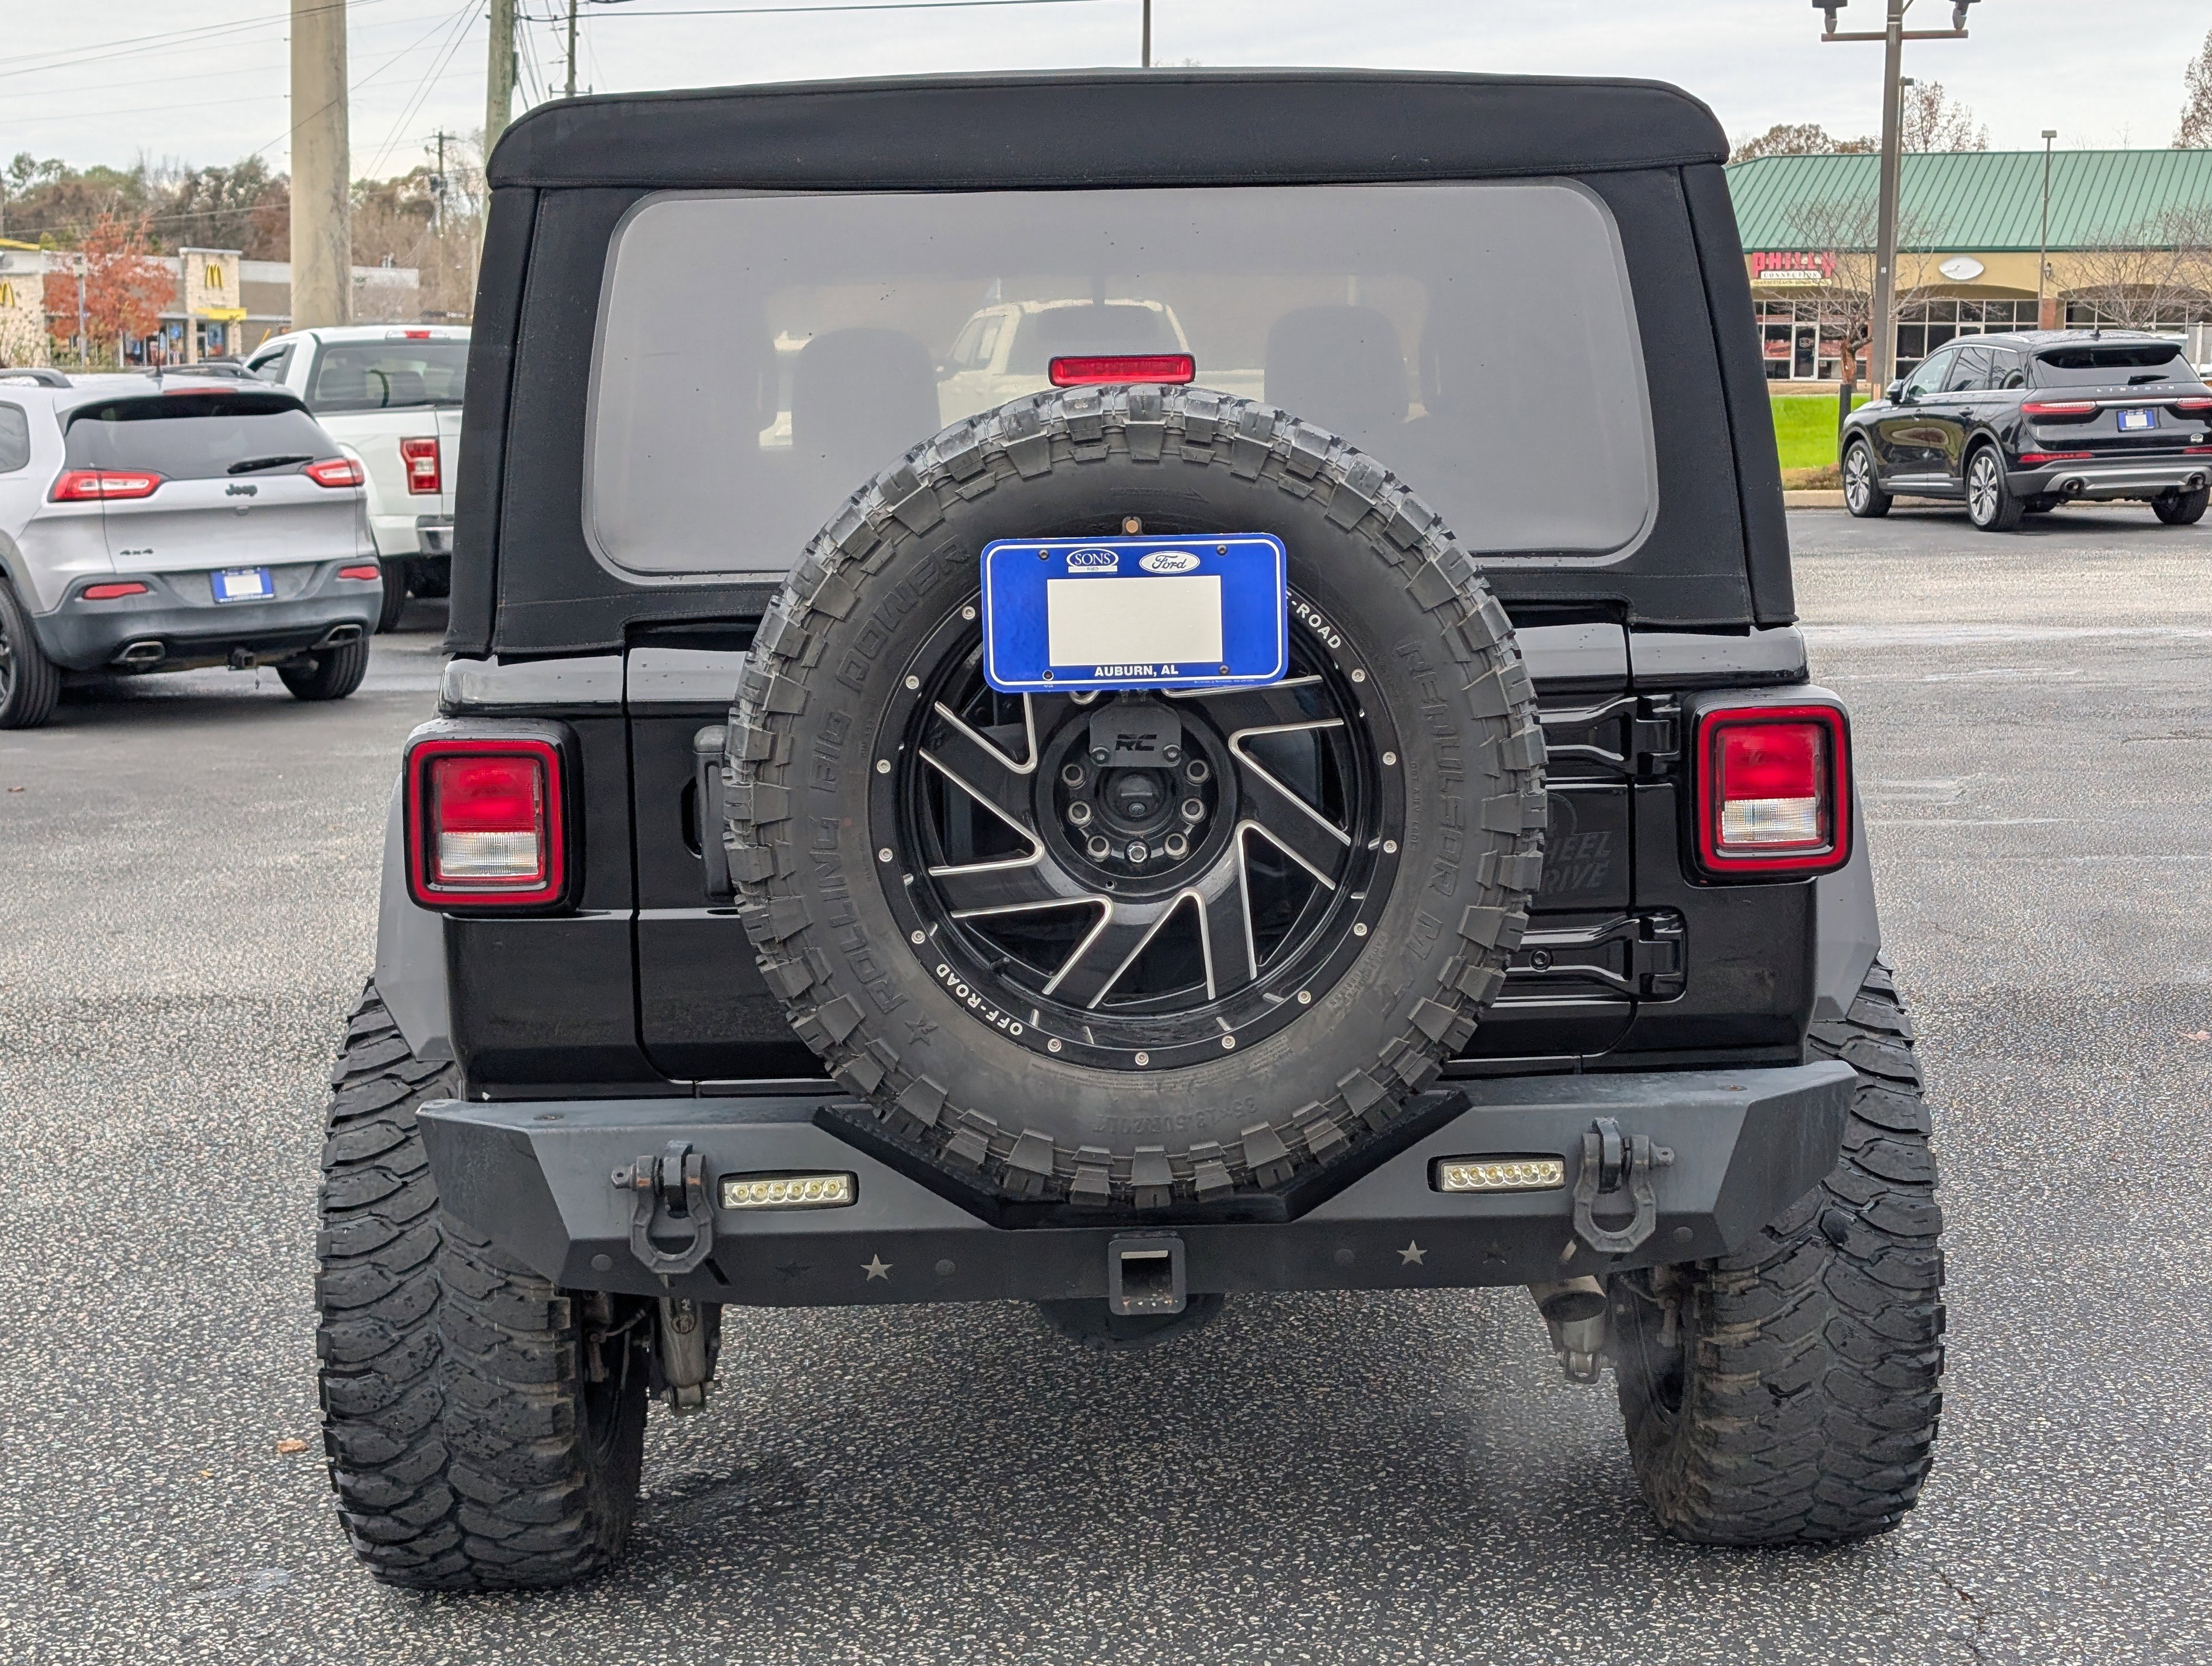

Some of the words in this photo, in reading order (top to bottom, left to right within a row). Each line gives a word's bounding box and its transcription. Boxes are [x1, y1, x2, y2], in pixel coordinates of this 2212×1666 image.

[1752, 252, 1835, 278] PHILLY
[225, 483, 258, 497] Jeep
[1075, 553, 1111, 565] SONS
[1151, 555, 1187, 569] Ford
[835, 539, 970, 694] POWER
[1285, 590, 1341, 649] -ROAD
[1094, 665, 1157, 677] AUBURN,
[1161, 664, 1179, 675] AL
[1115, 734, 1158, 751] RC
[1544, 831, 1611, 862] HEEL
[1542, 861, 1611, 894] RIVE
[936, 964, 1023, 1035] OFF-ROAD
